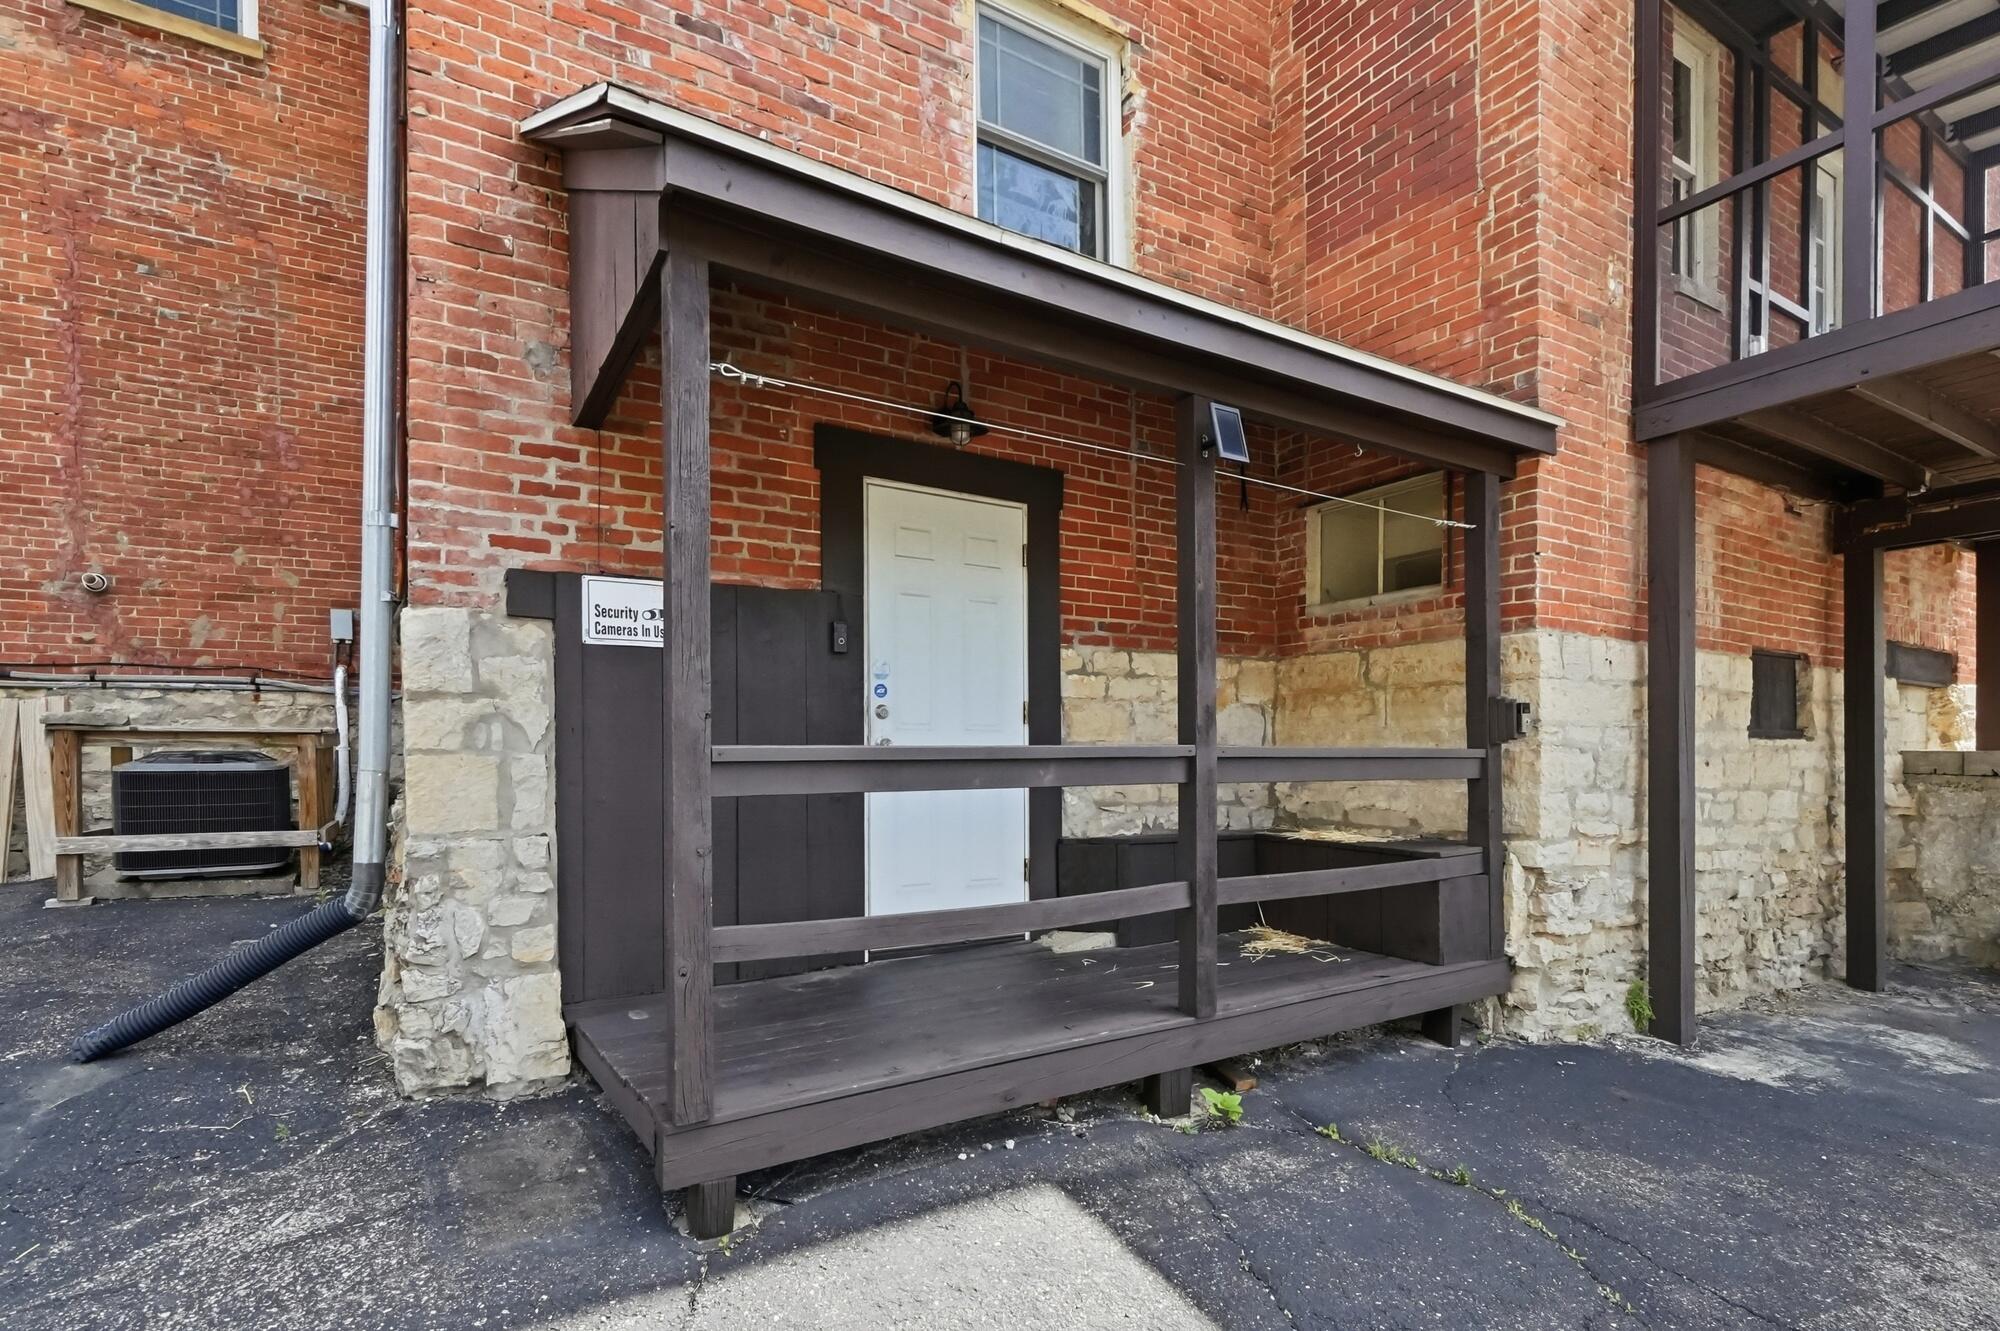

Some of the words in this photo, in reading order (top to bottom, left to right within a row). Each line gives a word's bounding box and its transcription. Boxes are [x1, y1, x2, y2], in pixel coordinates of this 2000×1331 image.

[594, 604, 639, 622] Security
[594, 621, 639, 637] Cameras
[641, 624, 651, 638] In
[654, 625, 664, 638] Us
